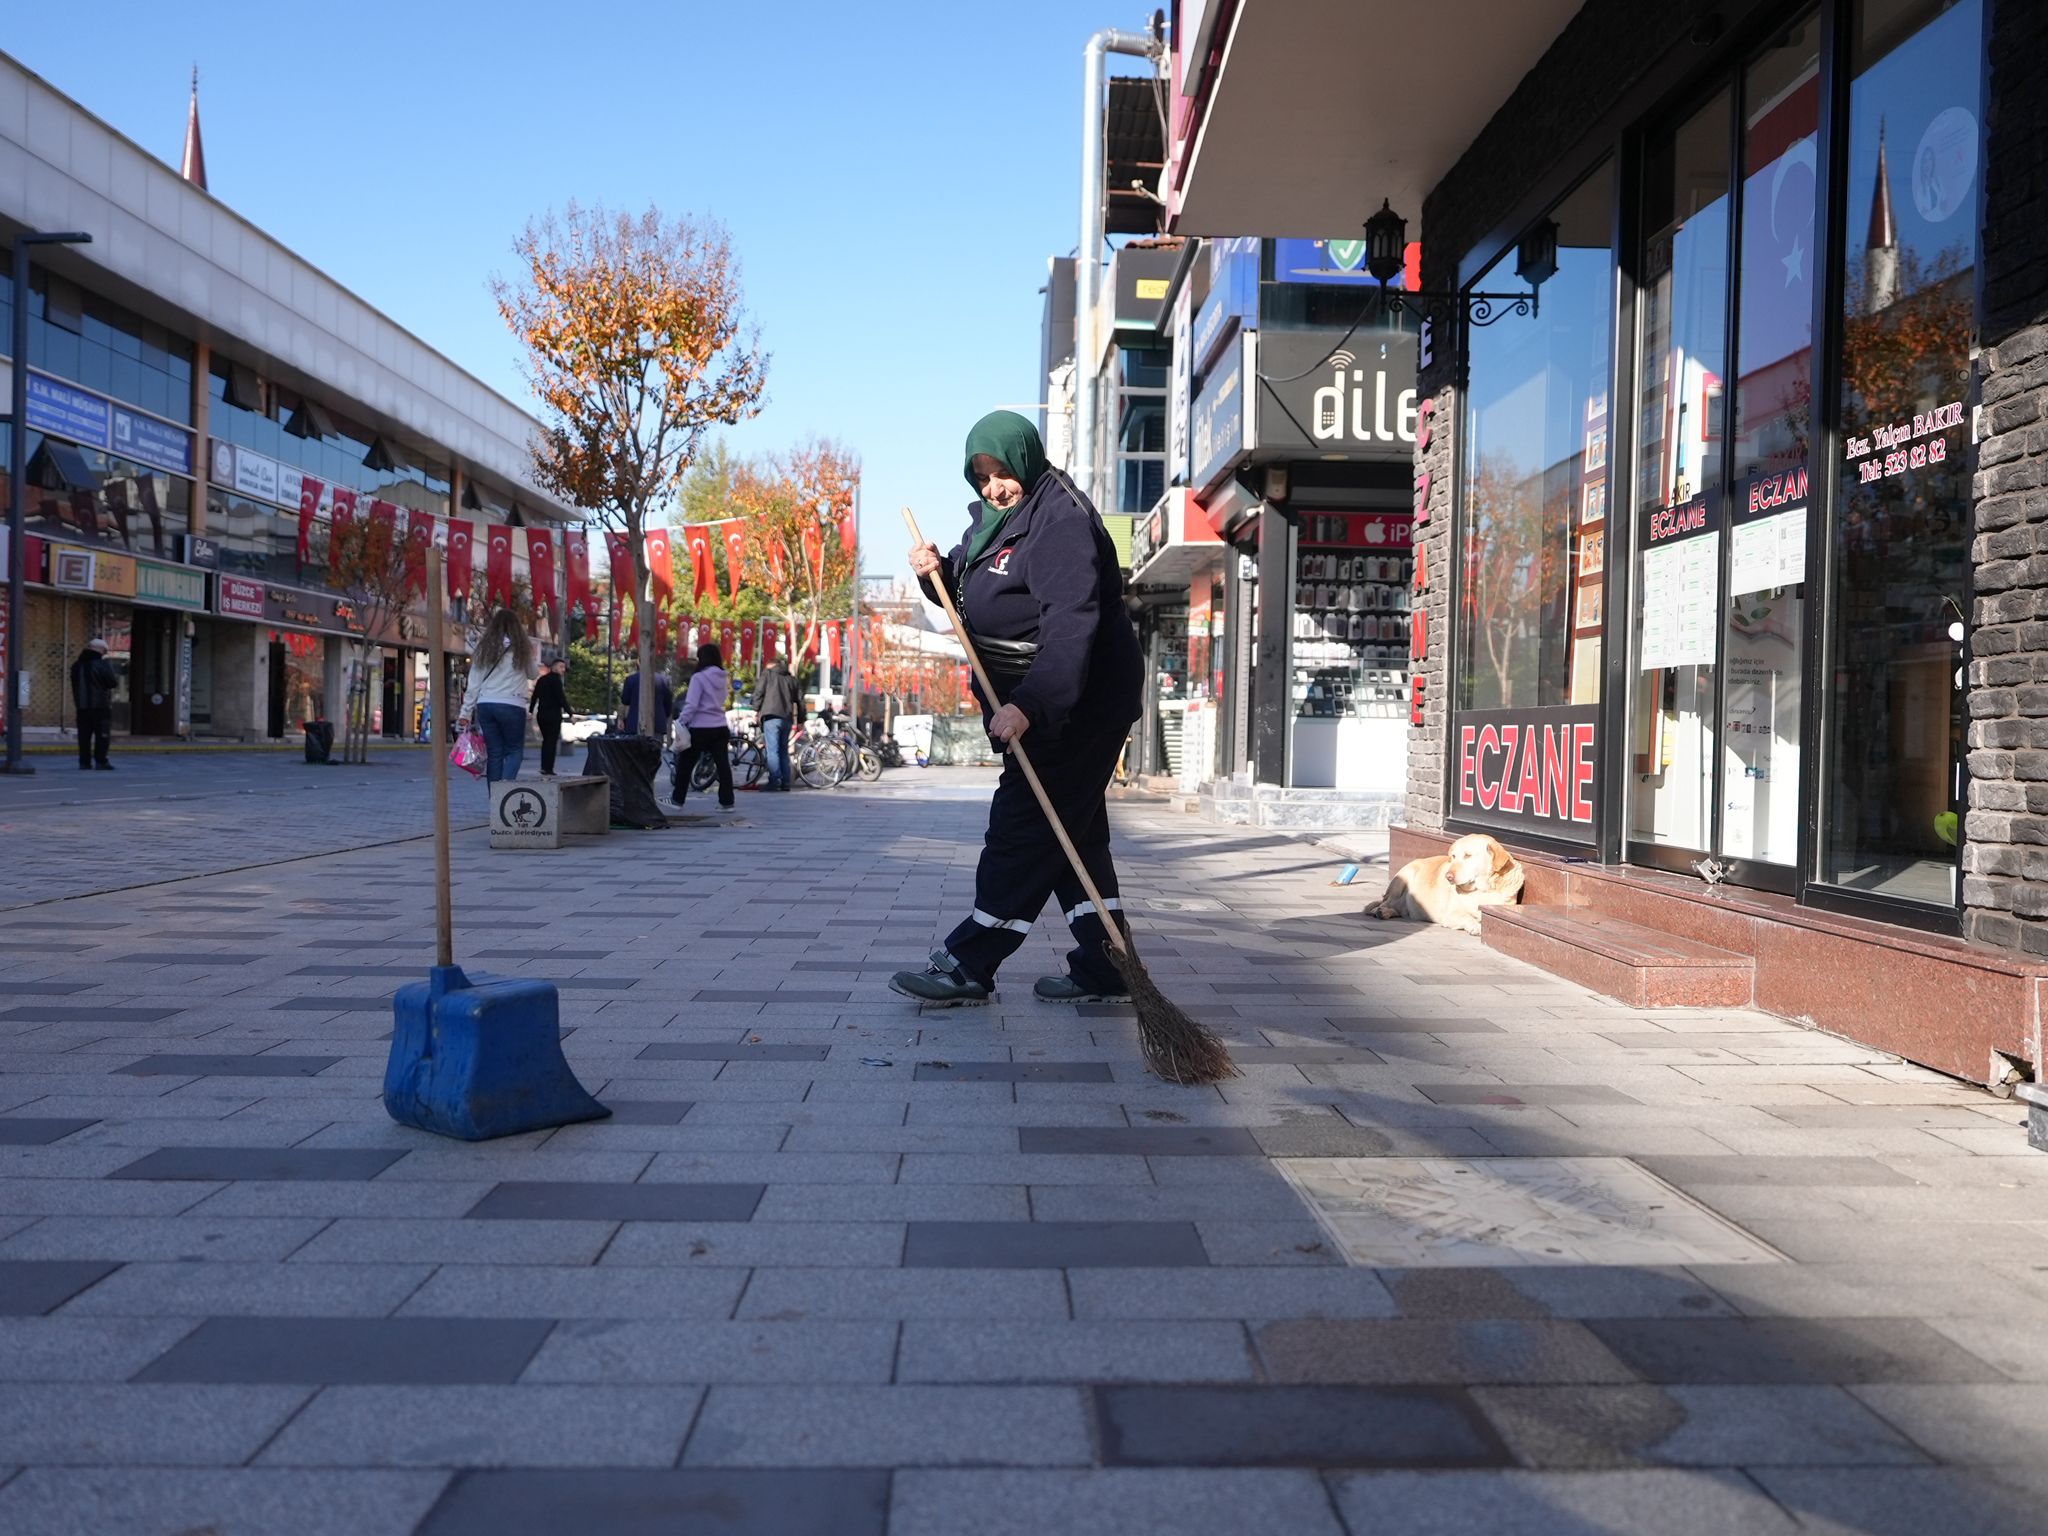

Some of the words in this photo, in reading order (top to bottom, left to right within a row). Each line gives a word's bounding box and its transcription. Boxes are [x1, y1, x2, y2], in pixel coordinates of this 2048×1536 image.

[1846, 436, 1871, 460] Ecz.
[1912, 401, 1965, 439] BAKIR
[1858, 458, 1883, 484] Tel:
[1884, 449, 1908, 478] 523
[1909, 443, 1927, 470] 82
[1928, 437, 1947, 464] 82
[1411, 315, 1434, 726] ECZANE
[1650, 499, 1707, 542] ECZANE
[231, 580, 256, 599] DÜZCE
[1459, 723, 1595, 824] ECZANE
